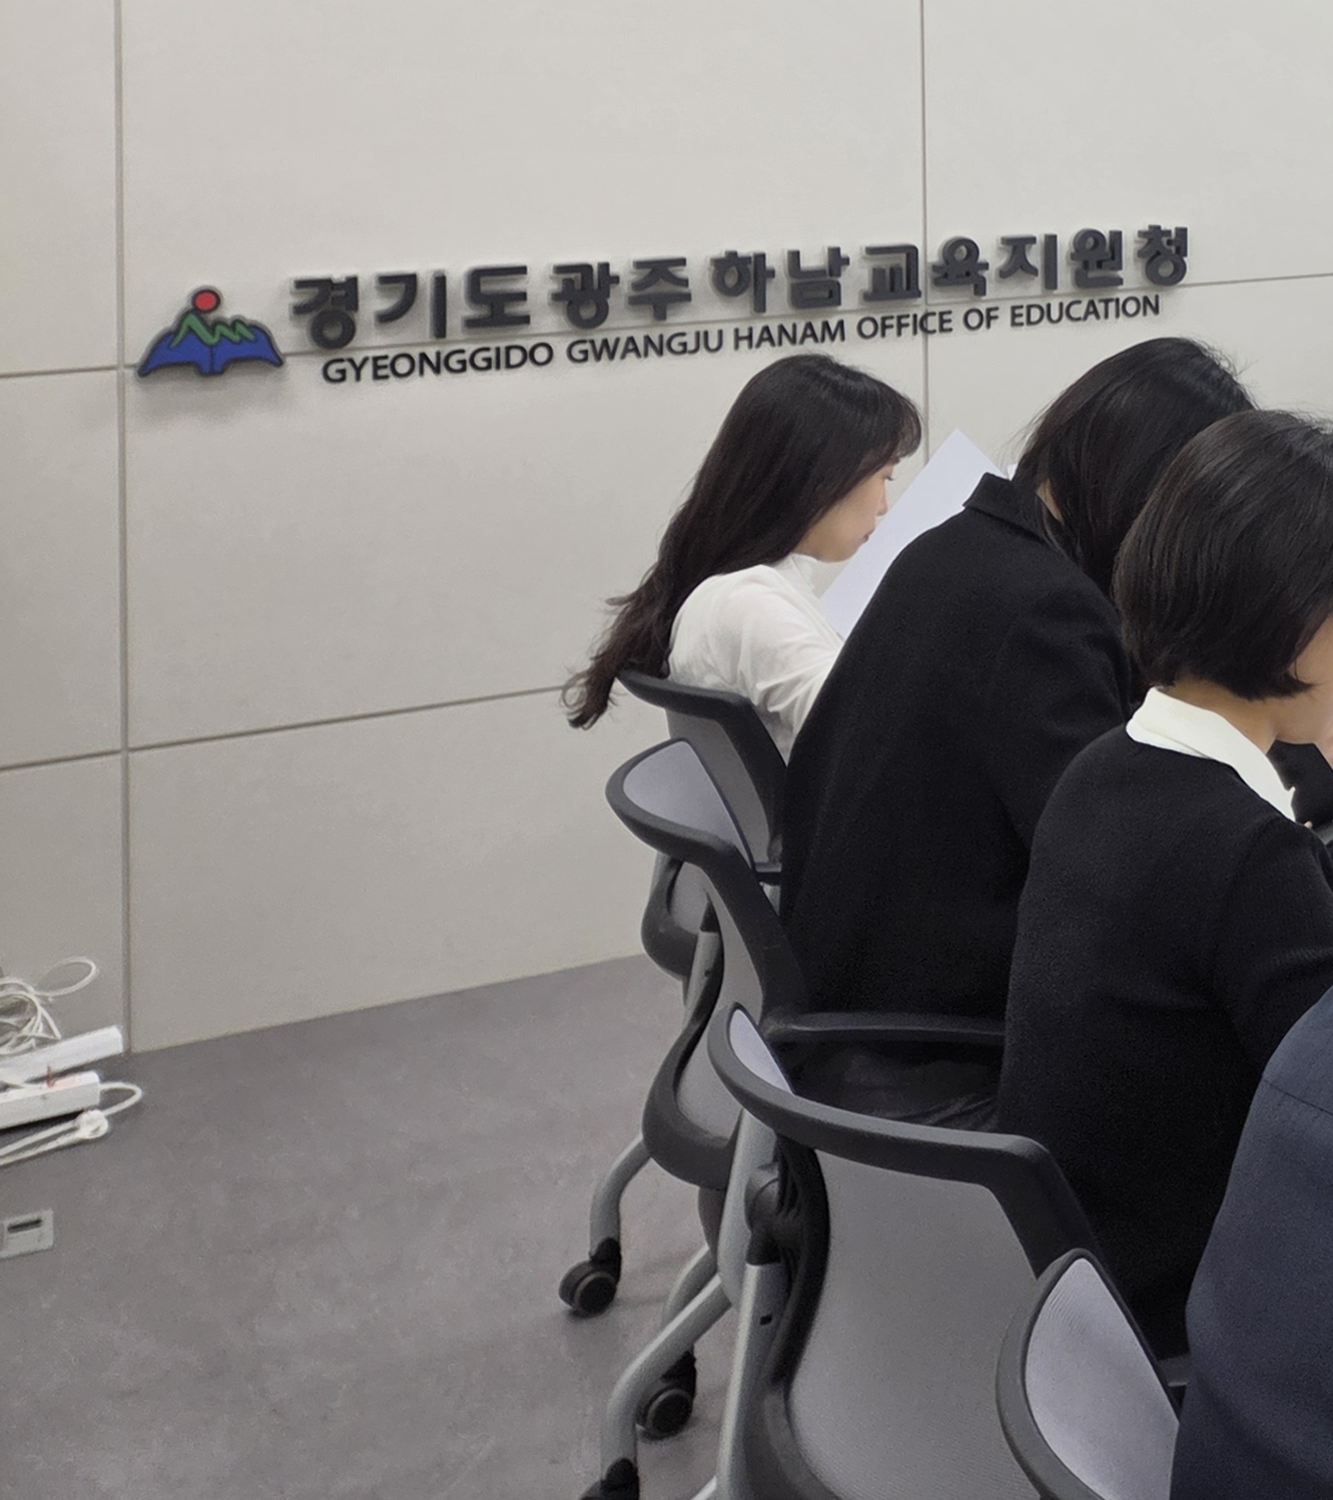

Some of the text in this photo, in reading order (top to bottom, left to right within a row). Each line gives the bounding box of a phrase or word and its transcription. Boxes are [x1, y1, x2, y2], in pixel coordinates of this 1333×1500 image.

[321, 294, 1161, 384] GYEONGGIDO GWANGJU HANAM OFFICE OF EDUCATION
